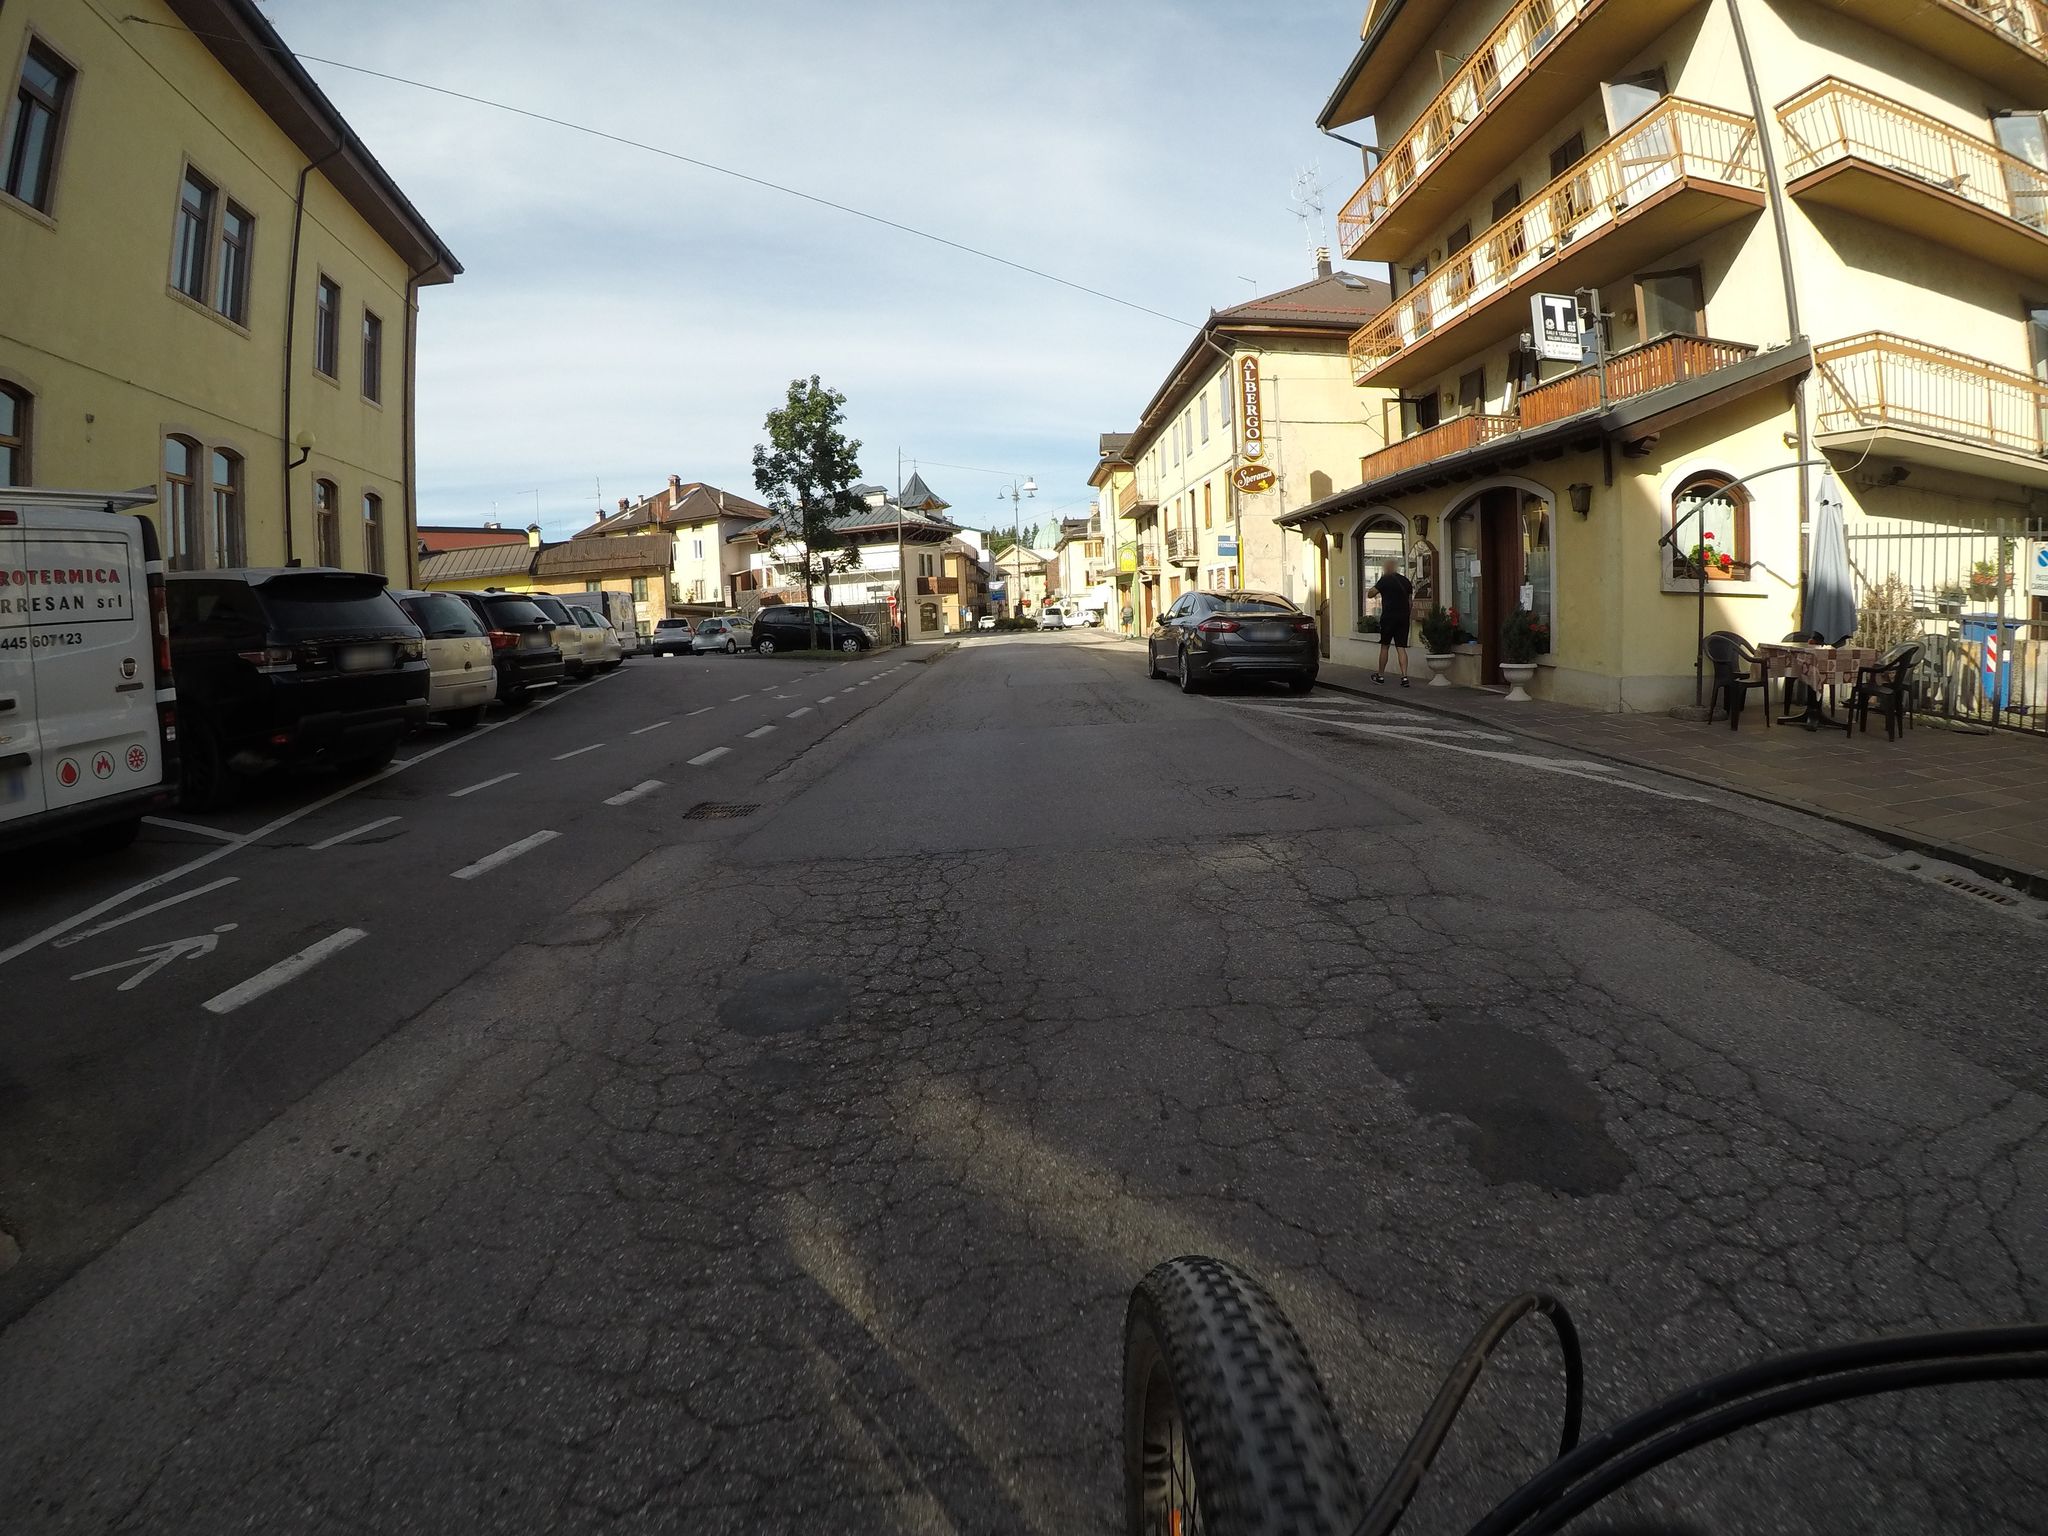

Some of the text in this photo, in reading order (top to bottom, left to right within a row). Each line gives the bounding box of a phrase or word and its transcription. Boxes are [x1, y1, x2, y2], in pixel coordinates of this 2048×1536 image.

[1545, 297, 1571, 331] T
[1243, 359, 1260, 439] ALBERGO
[1237, 470, 1272, 488] Speranza
[97, 595, 122, 608] srl
[32, 633, 82, 648] 607123
